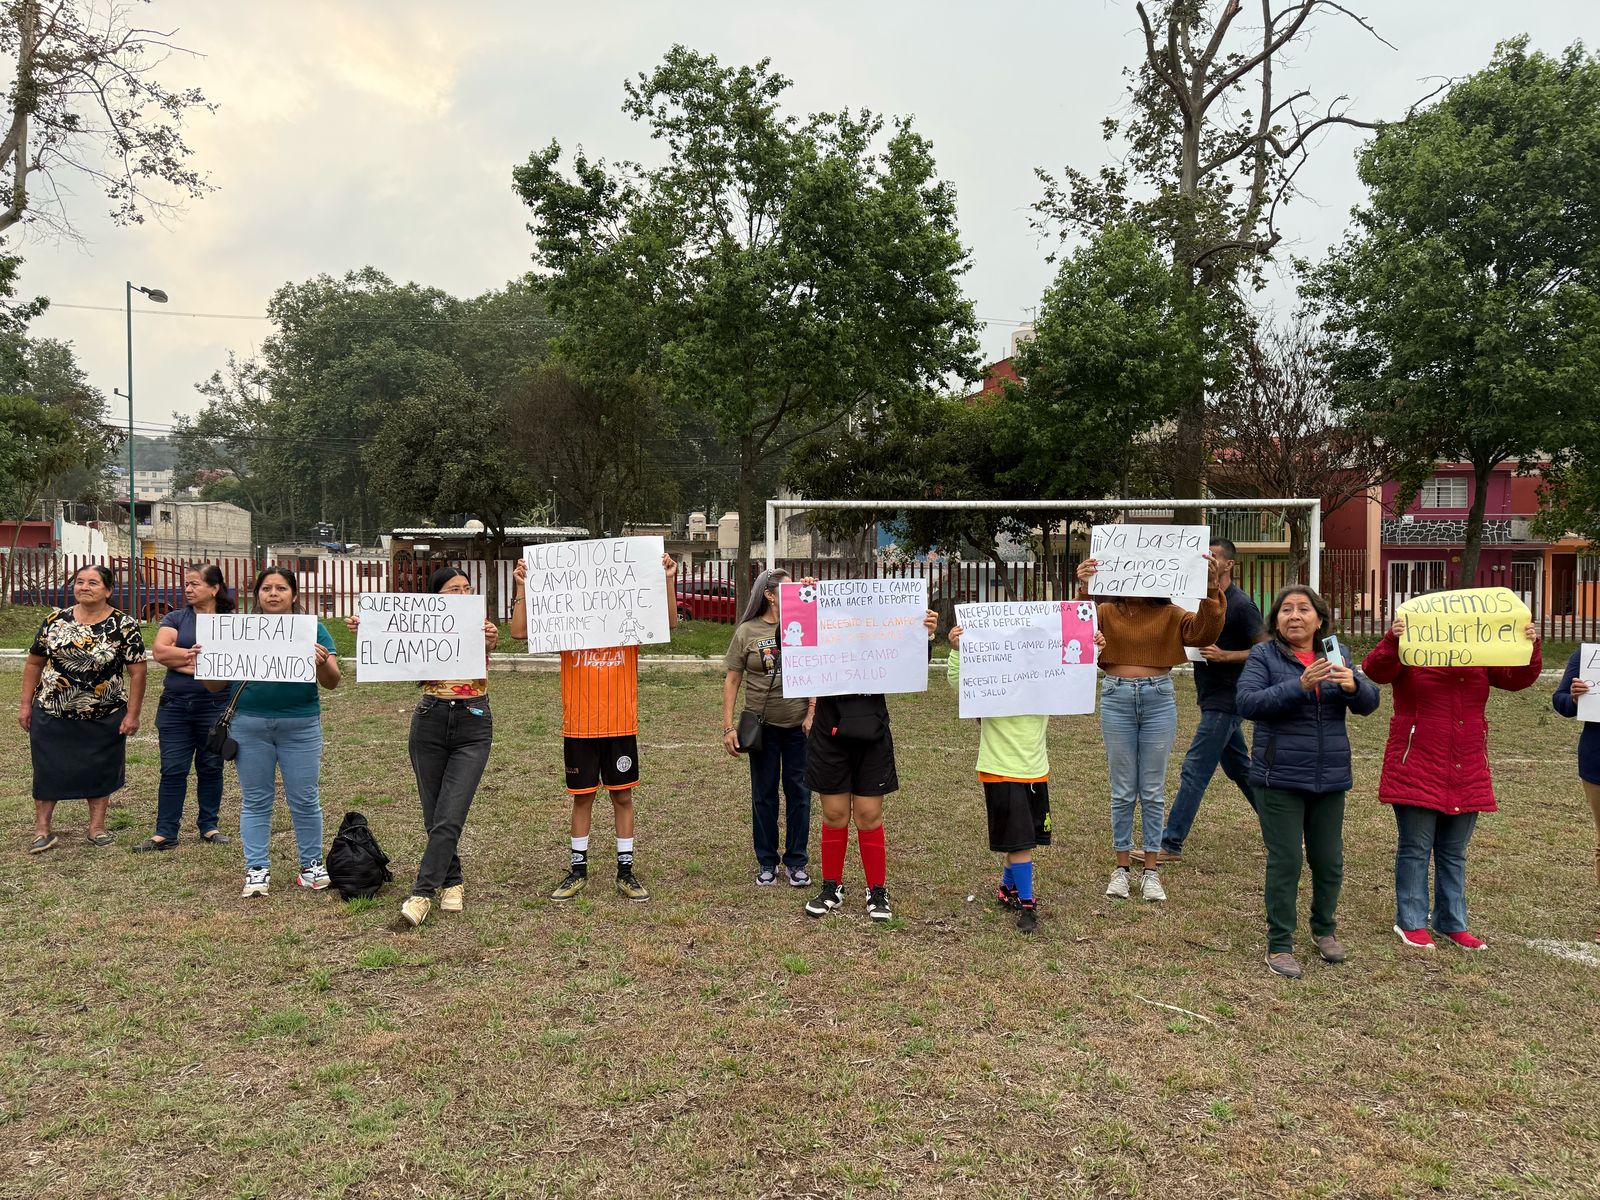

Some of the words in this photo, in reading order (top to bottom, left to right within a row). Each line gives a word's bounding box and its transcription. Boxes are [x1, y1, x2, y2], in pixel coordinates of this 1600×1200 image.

[1136, 526, 1201, 551] basta
[528, 541, 607, 570] NECESITO
[613, 541, 636, 563] EL
[1094, 556, 1180, 572] estamos
[529, 569, 587, 592] CAMPO
[595, 565, 636, 587] PARA
[820, 582, 868, 596] NECESITO
[872, 582, 884, 593] EL
[889, 581, 922, 593] CAMPO
[360, 595, 447, 612] QUEREMOS
[532, 593, 574, 615] HACER
[582, 588, 652, 611] DEPORTE,
[820, 597, 842, 608] PARA
[846, 596, 873, 606] HACER
[879, 595, 920, 605] DEPORTE
[958, 604, 1001, 619] NECESITO
[1003, 604, 1015, 616] EL
[1018, 604, 1050, 616] CAMPO
[1052, 604, 1072, 613] PARA
[212, 616, 294, 642] ¡FUERA!
[387, 613, 455, 633] ABIERTO
[531, 616, 593, 634] DIVERTIRME
[598, 614, 607, 632] Y
[820, 618, 861, 630] NECESITO
[866, 618, 878, 627] EL
[883, 616, 917, 626] CAMPO
[961, 618, 989, 629] HACER
[1405, 613, 1492, 643] habierto
[1498, 619, 1517, 642] el
[361, 640, 379, 665] EL
[384, 638, 460, 664] CAMPO!
[529, 636, 540, 652] MI
[545, 632, 585, 652] SALUD
[962, 641, 1000, 653] NECESITO
[1004, 640, 1015, 651] EL
[1017, 640, 1044, 650] CAMPO
[195, 652, 257, 678] ESTEBAN
[261, 655, 316, 681] SANTOS
[784, 654, 836, 668] NECESITO
[841, 651, 858, 663] EL
[861, 648, 899, 661] CAMPO
[963, 653, 1013, 664] DIVERTIRME
[1403, 648, 1474, 666] campo.
[786, 674, 813, 688] PARA
[821, 672, 838, 684] MI
[845, 667, 887, 681] SALUD
[963, 675, 998, 687] NECESITO
[1001, 674, 1013, 683] EL
[1013, 670, 1040, 681] CAMPO
[1044, 668, 1066, 678] PARA
[963, 690, 976, 699] MI
[981, 688, 1007, 697] SALUD
